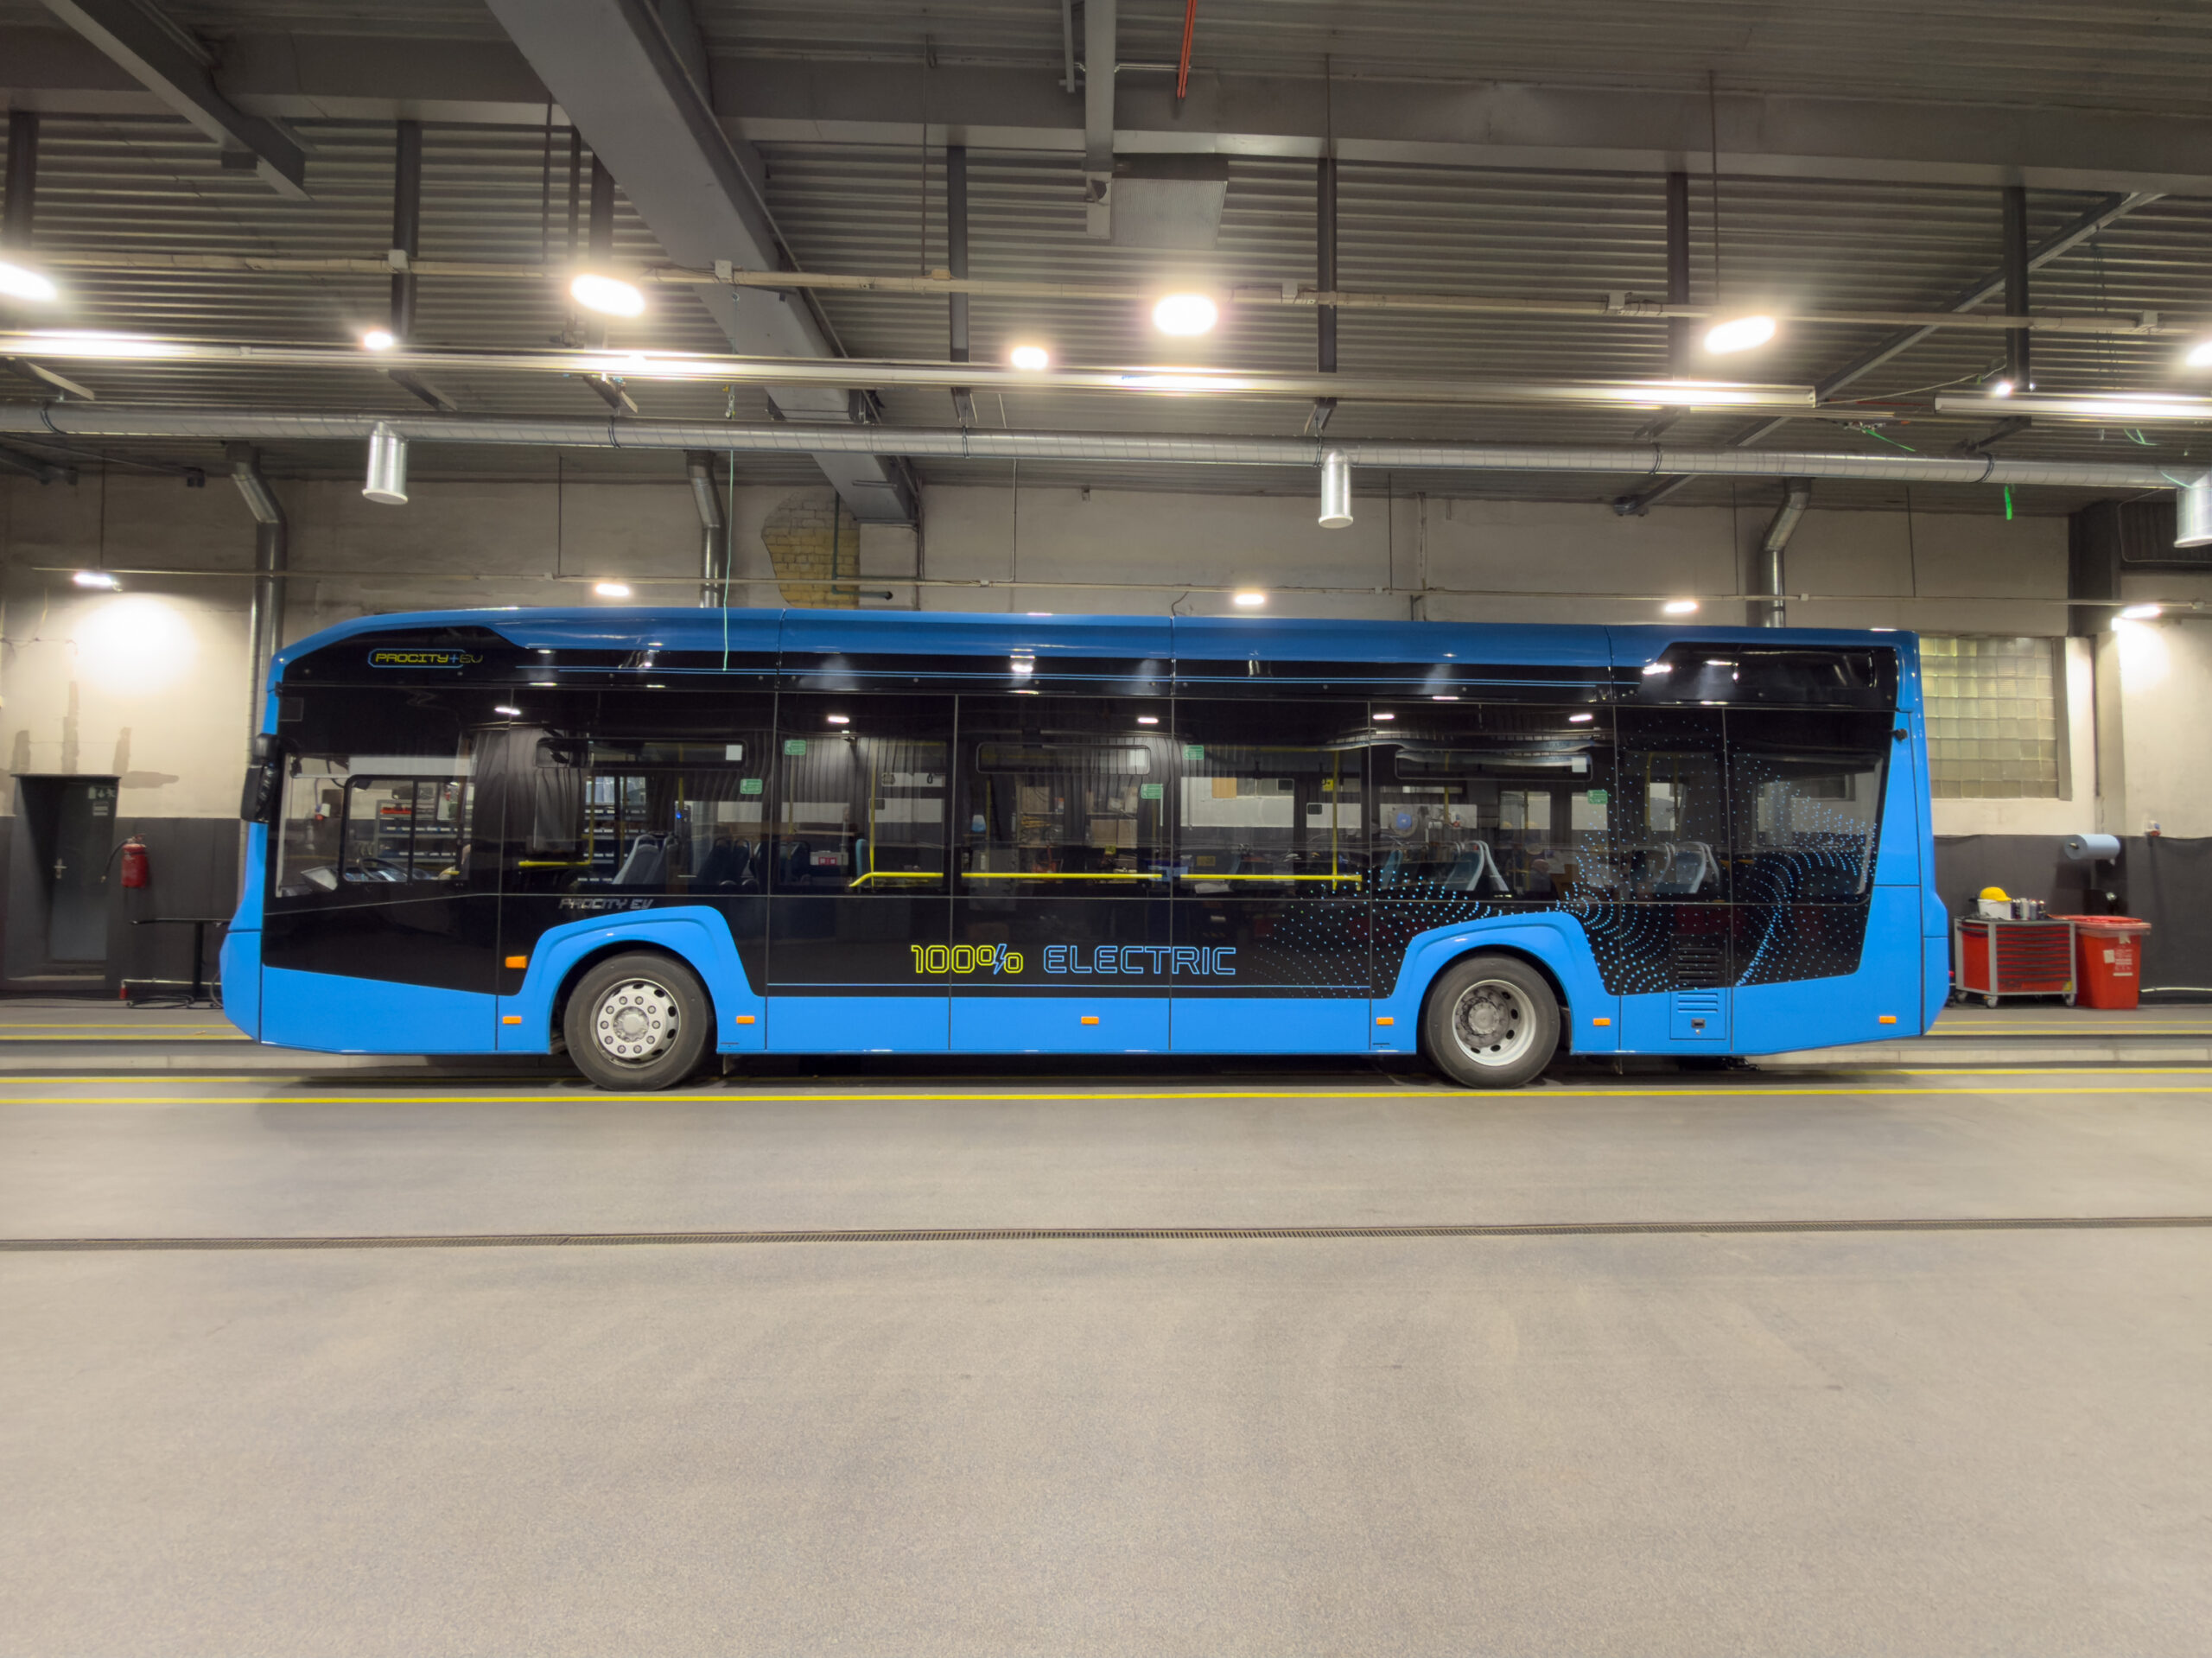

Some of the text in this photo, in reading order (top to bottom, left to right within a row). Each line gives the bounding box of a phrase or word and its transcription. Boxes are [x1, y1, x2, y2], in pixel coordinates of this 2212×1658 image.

[558, 898, 654, 910] PROCITY EV
[911, 943, 1236, 975] 100% ELECTRIC
